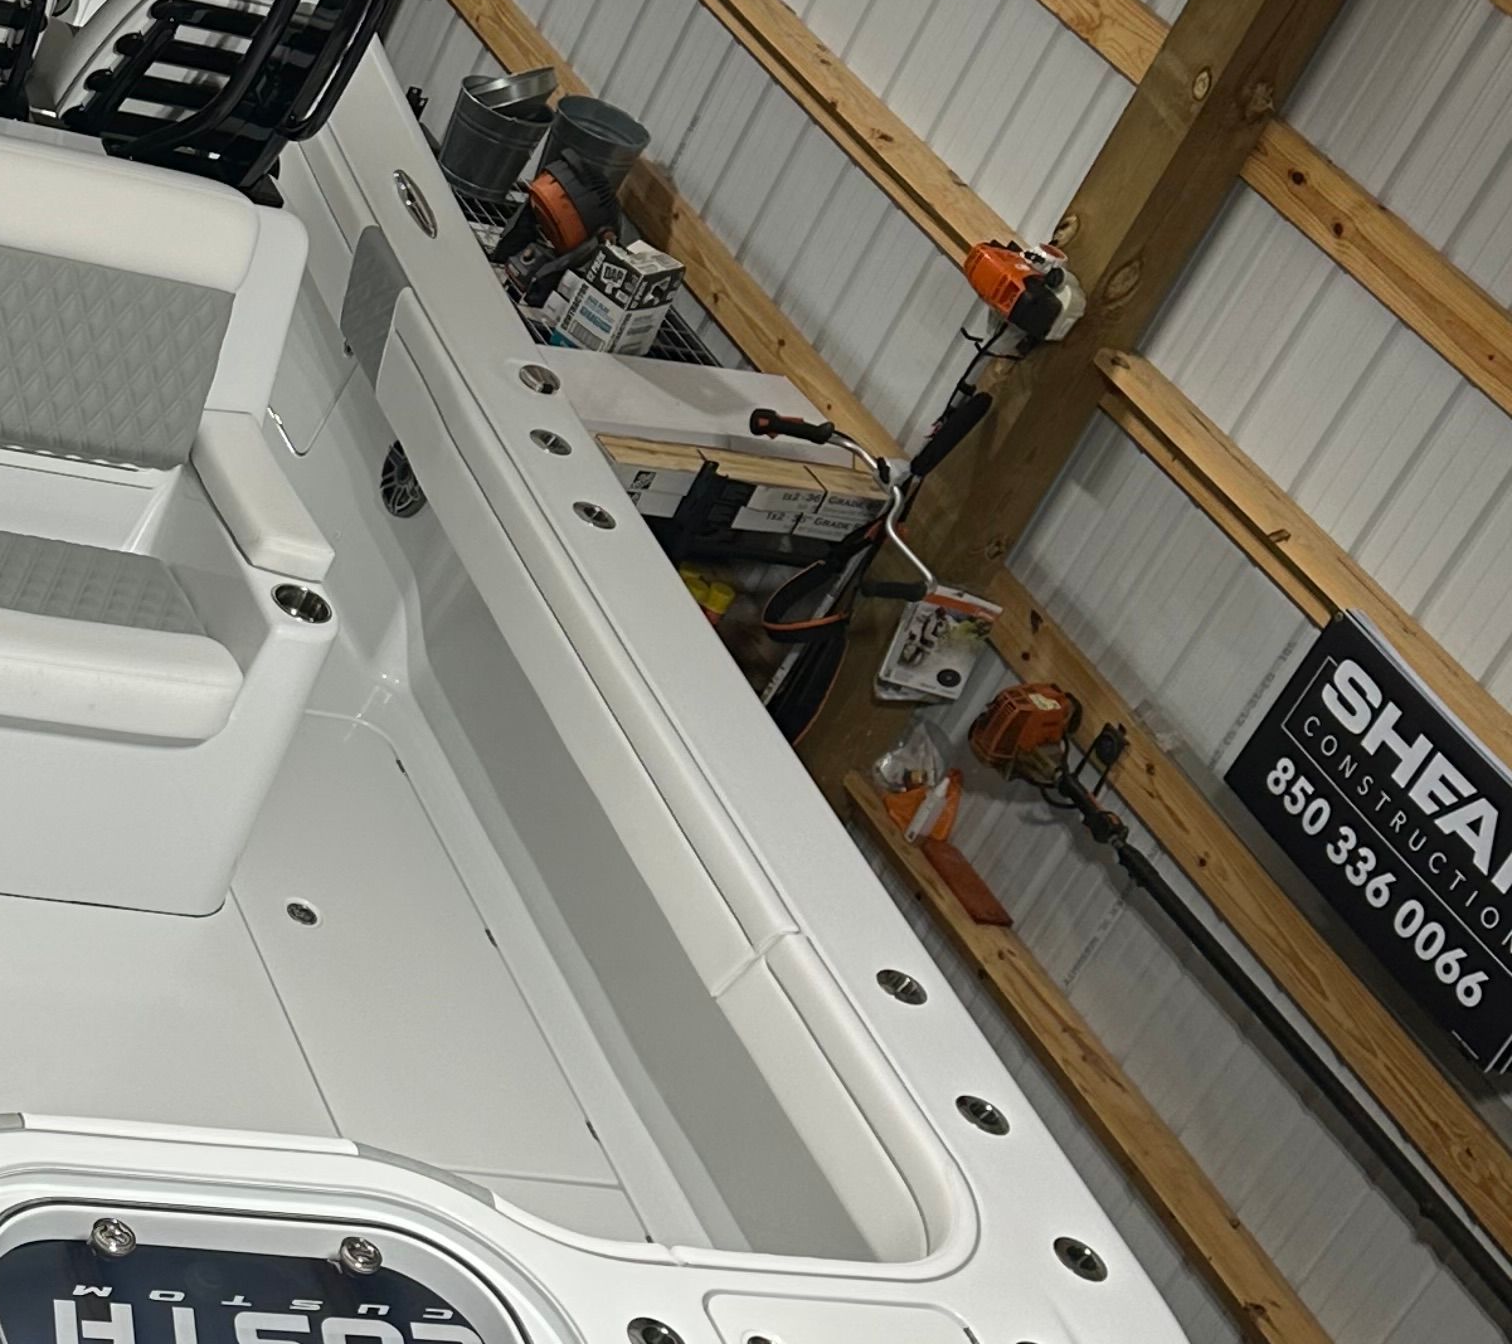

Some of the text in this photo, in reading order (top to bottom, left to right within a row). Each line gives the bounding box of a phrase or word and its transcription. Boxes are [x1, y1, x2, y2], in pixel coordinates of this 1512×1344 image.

[1266, 758, 1490, 1008] 850 336 0066
[73, 1284, 455, 1320] CUSTOM
